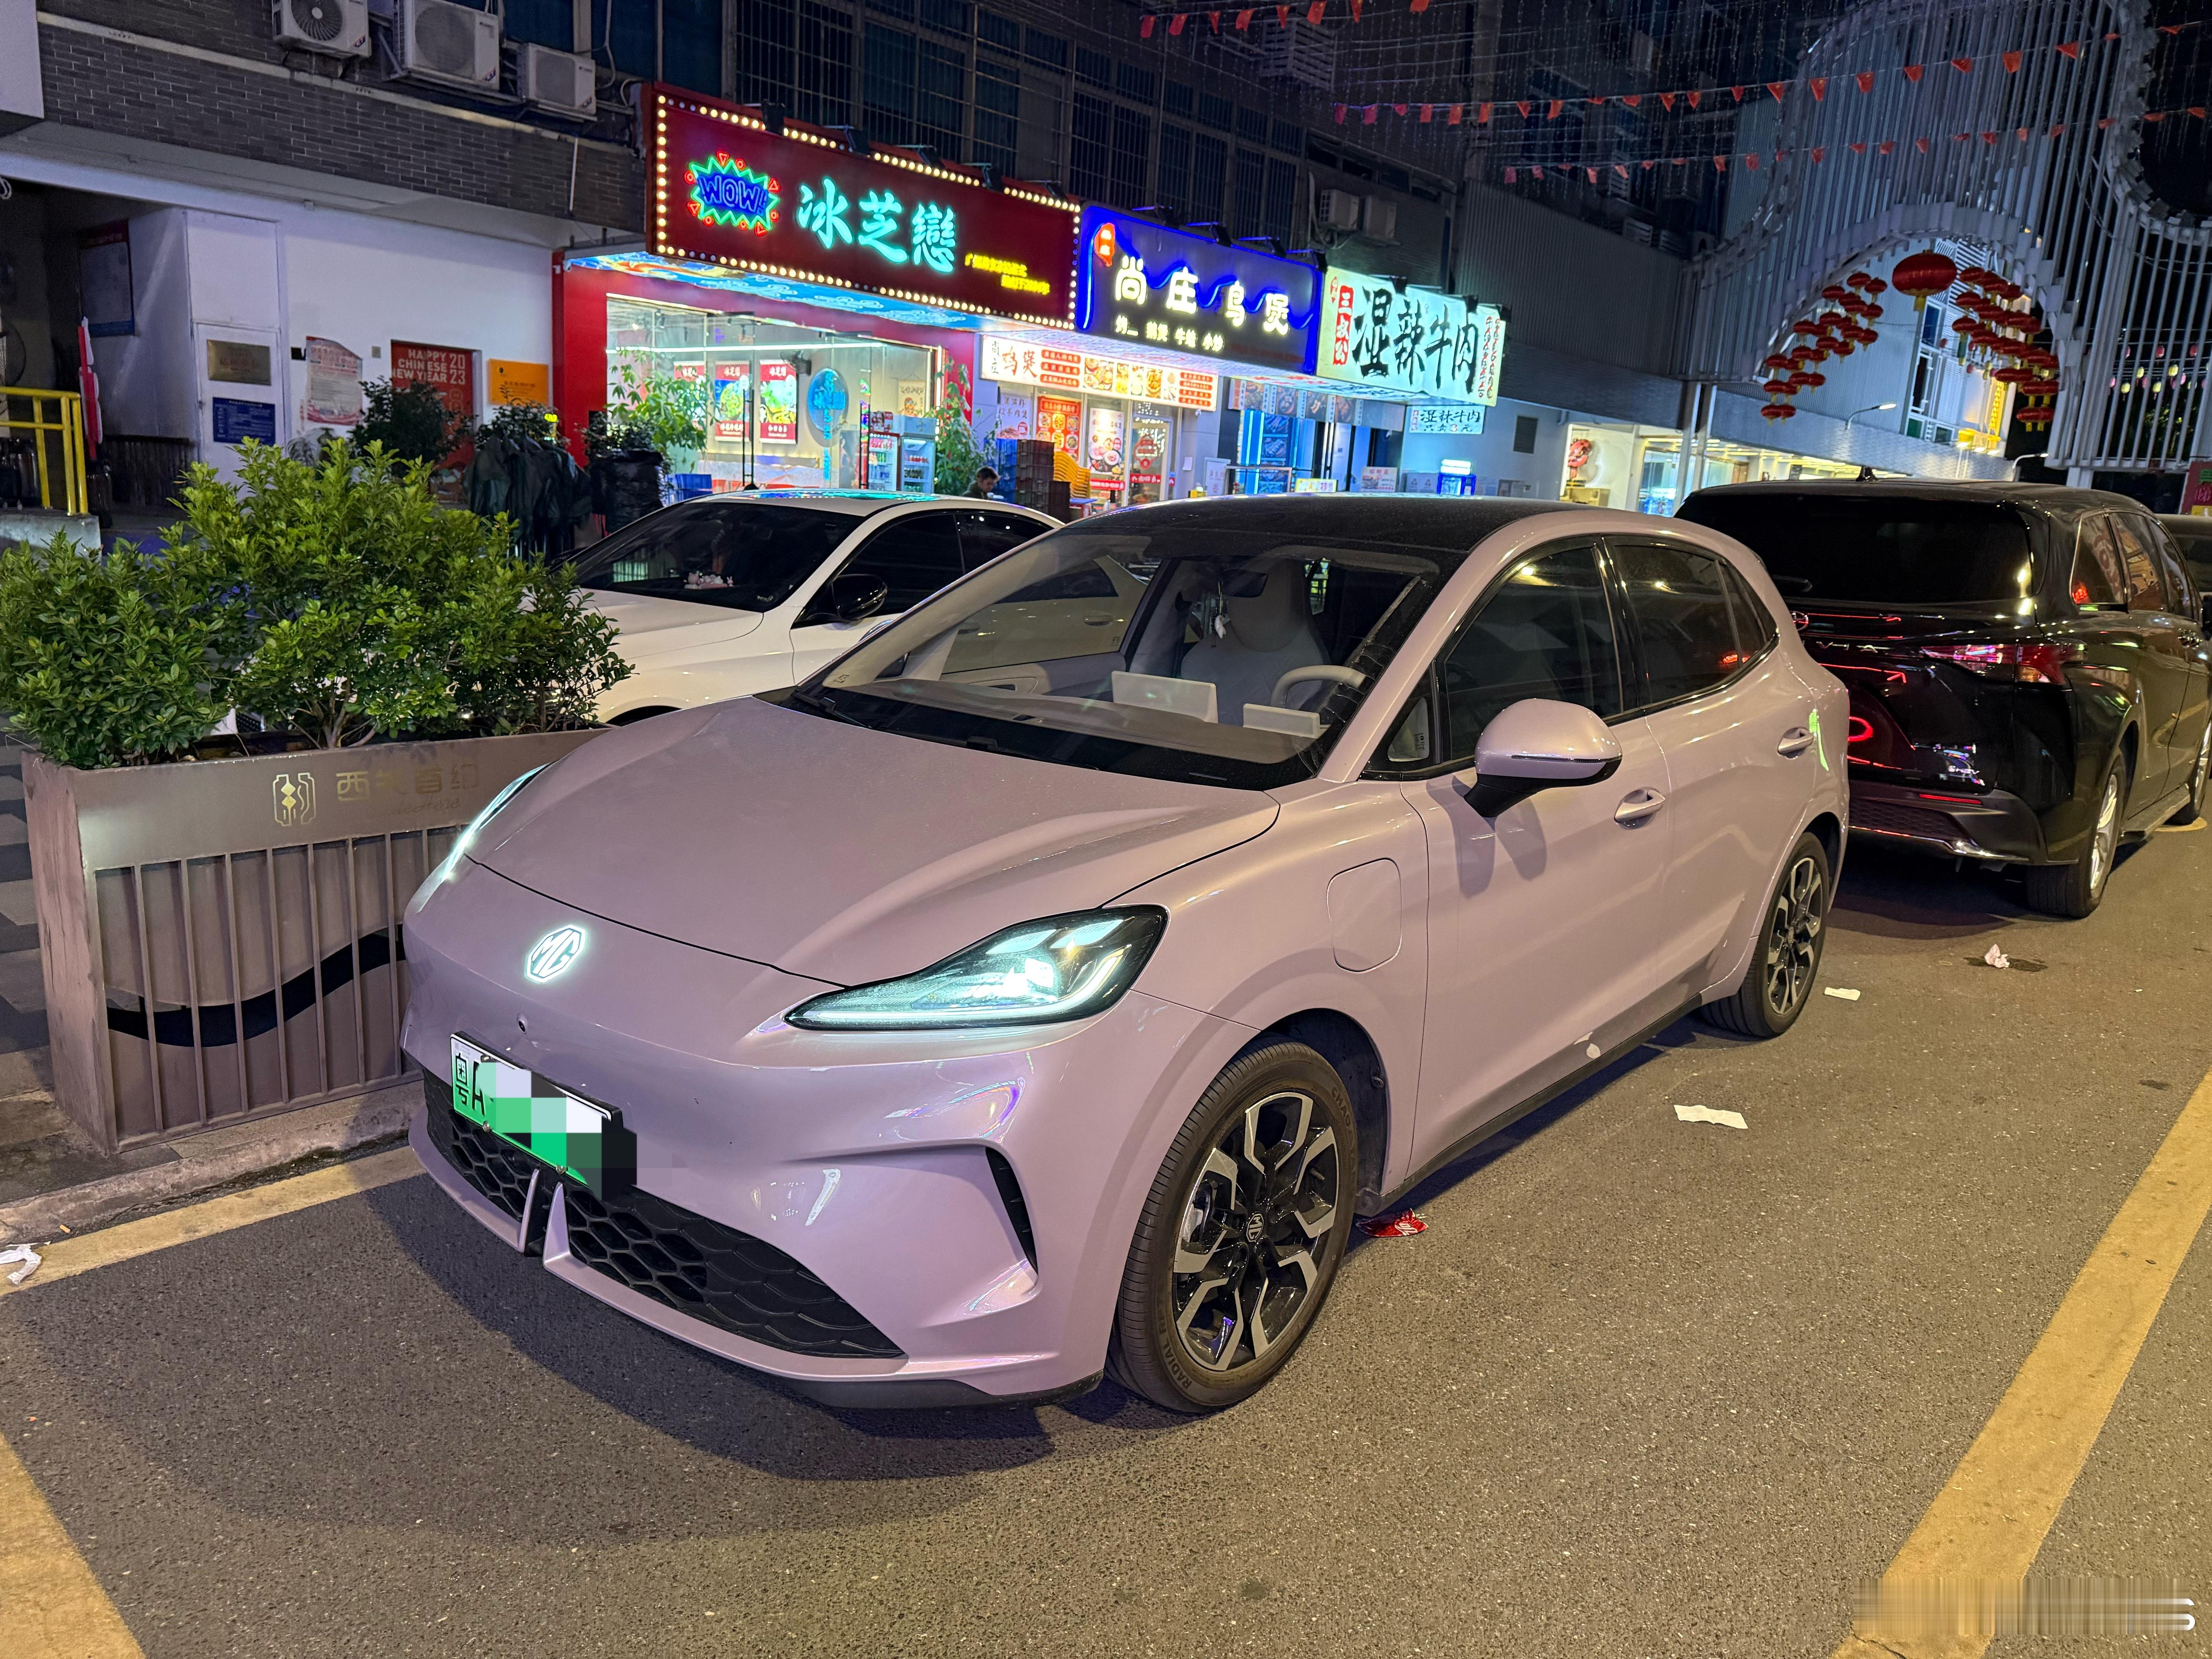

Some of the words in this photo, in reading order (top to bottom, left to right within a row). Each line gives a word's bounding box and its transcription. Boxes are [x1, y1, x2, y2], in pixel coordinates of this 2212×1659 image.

[797, 177, 956, 273] 冰芝戀
[409, 349, 446, 361] HAPPY
[450, 353, 465, 369] 20
[398, 358, 447, 372] CHINESE
[417, 371, 447, 383] YEAR
[450, 369, 465, 384] 23
[531, 930, 582, 978] MG
[1248, 1216, 1262, 1240] MG
[1163, 1339, 1192, 1389] RADIAL
